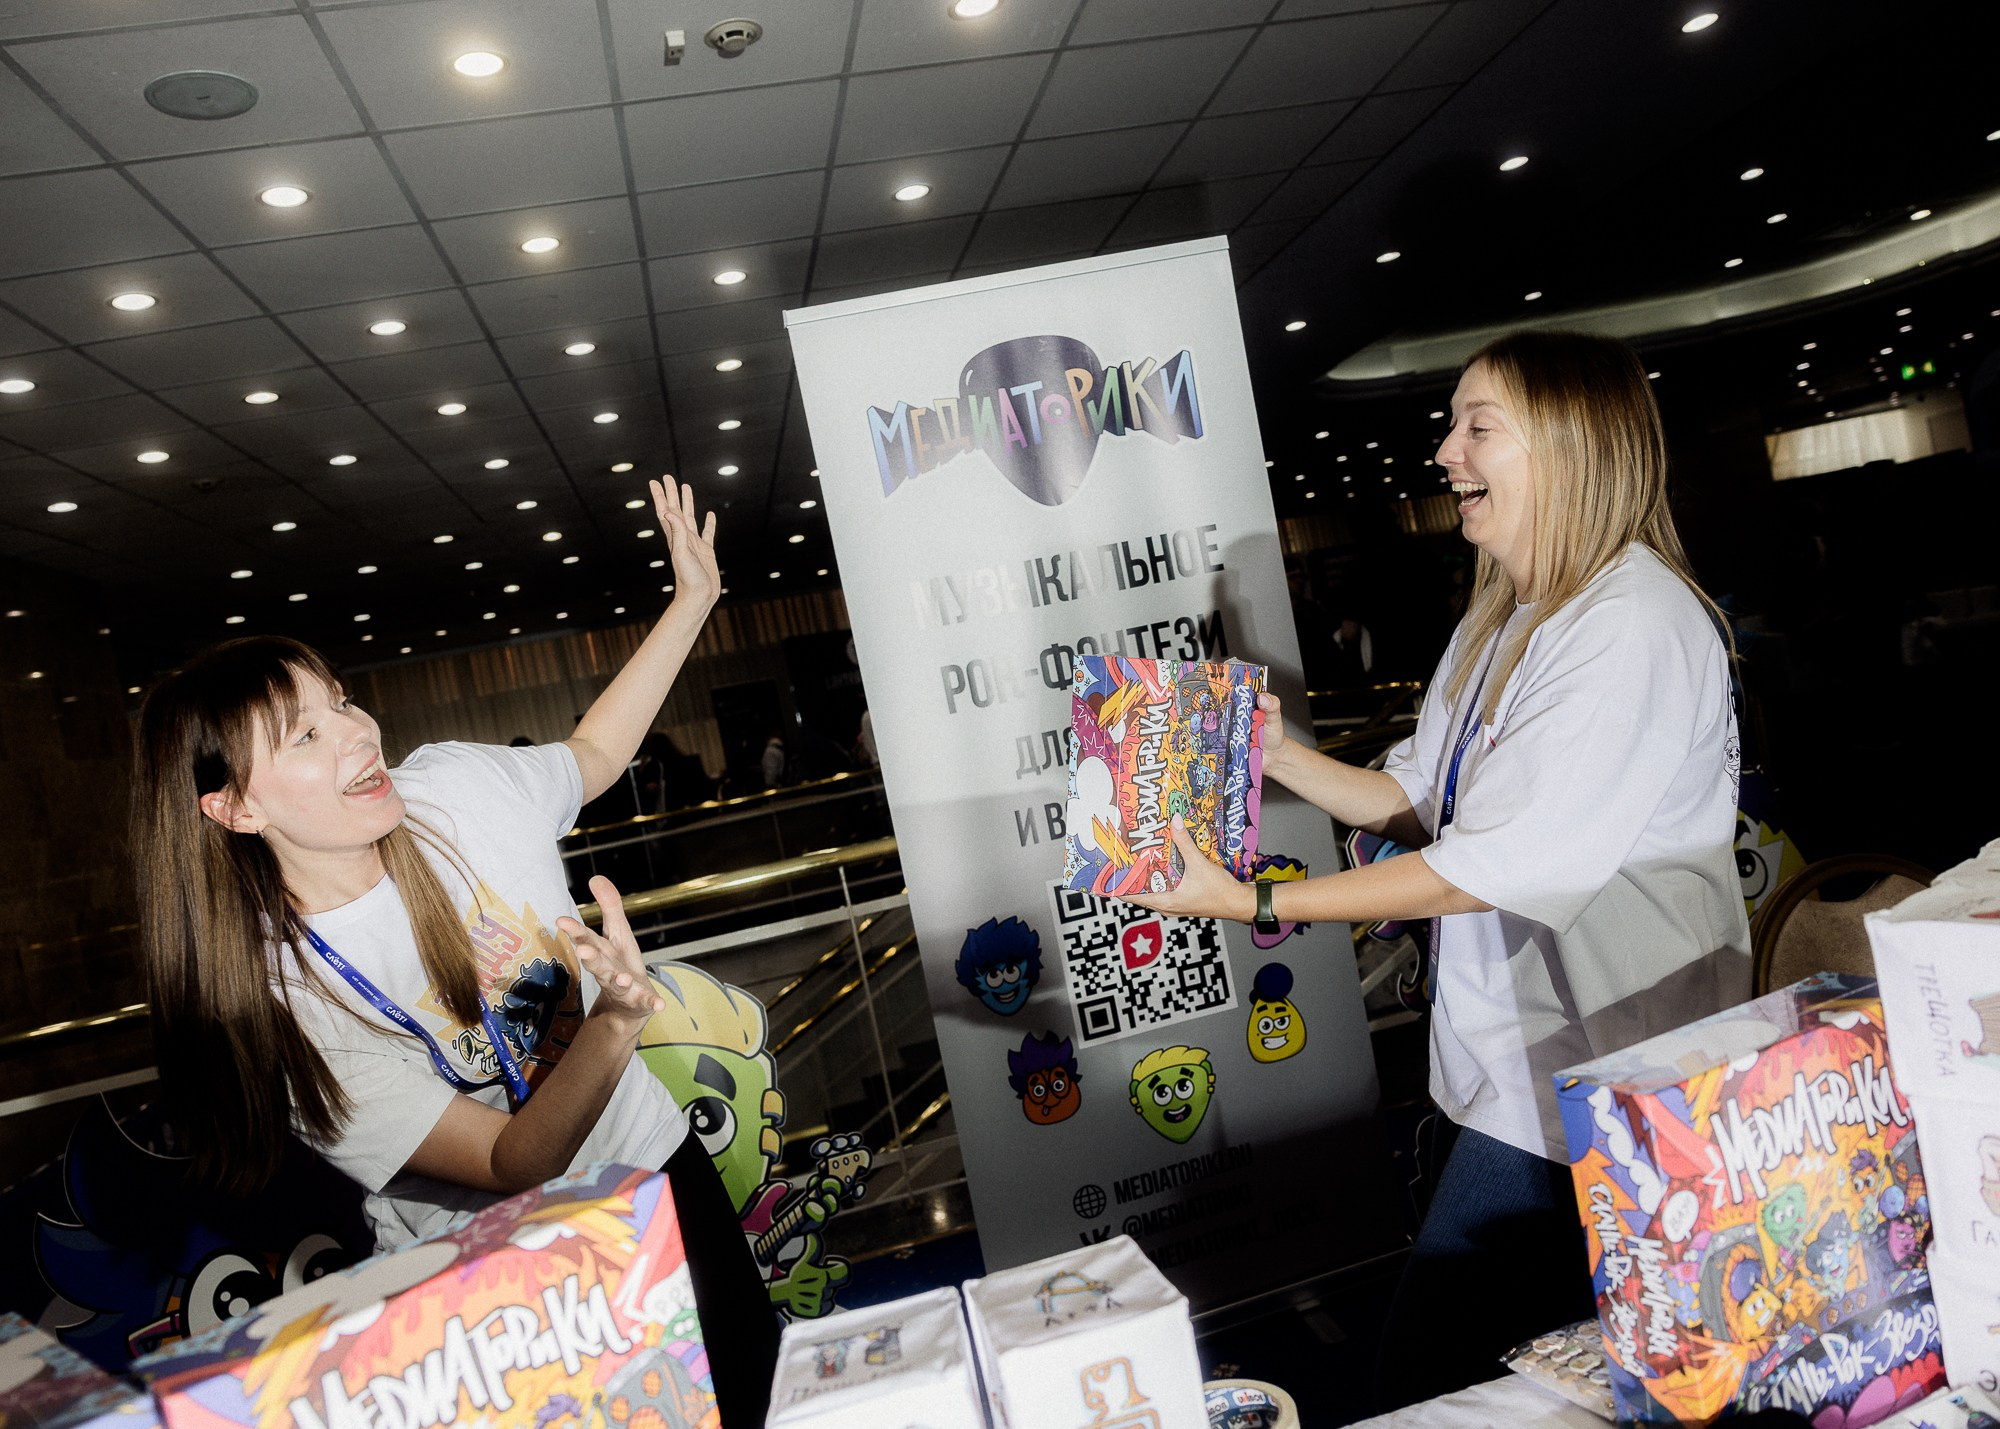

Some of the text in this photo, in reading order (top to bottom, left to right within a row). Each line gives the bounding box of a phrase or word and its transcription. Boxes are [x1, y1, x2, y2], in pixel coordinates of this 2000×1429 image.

[866, 350, 1203, 498] МЕДИАТОРИКИ
[911, 524, 1225, 629] МУЗЫКАЛЬНОЕ
[1129, 693, 1173, 852] МЕДИАТОРИКИ
[1014, 807, 1039, 847] И
[1113, 1142, 1254, 1205] MEDIATORIKI.RU
